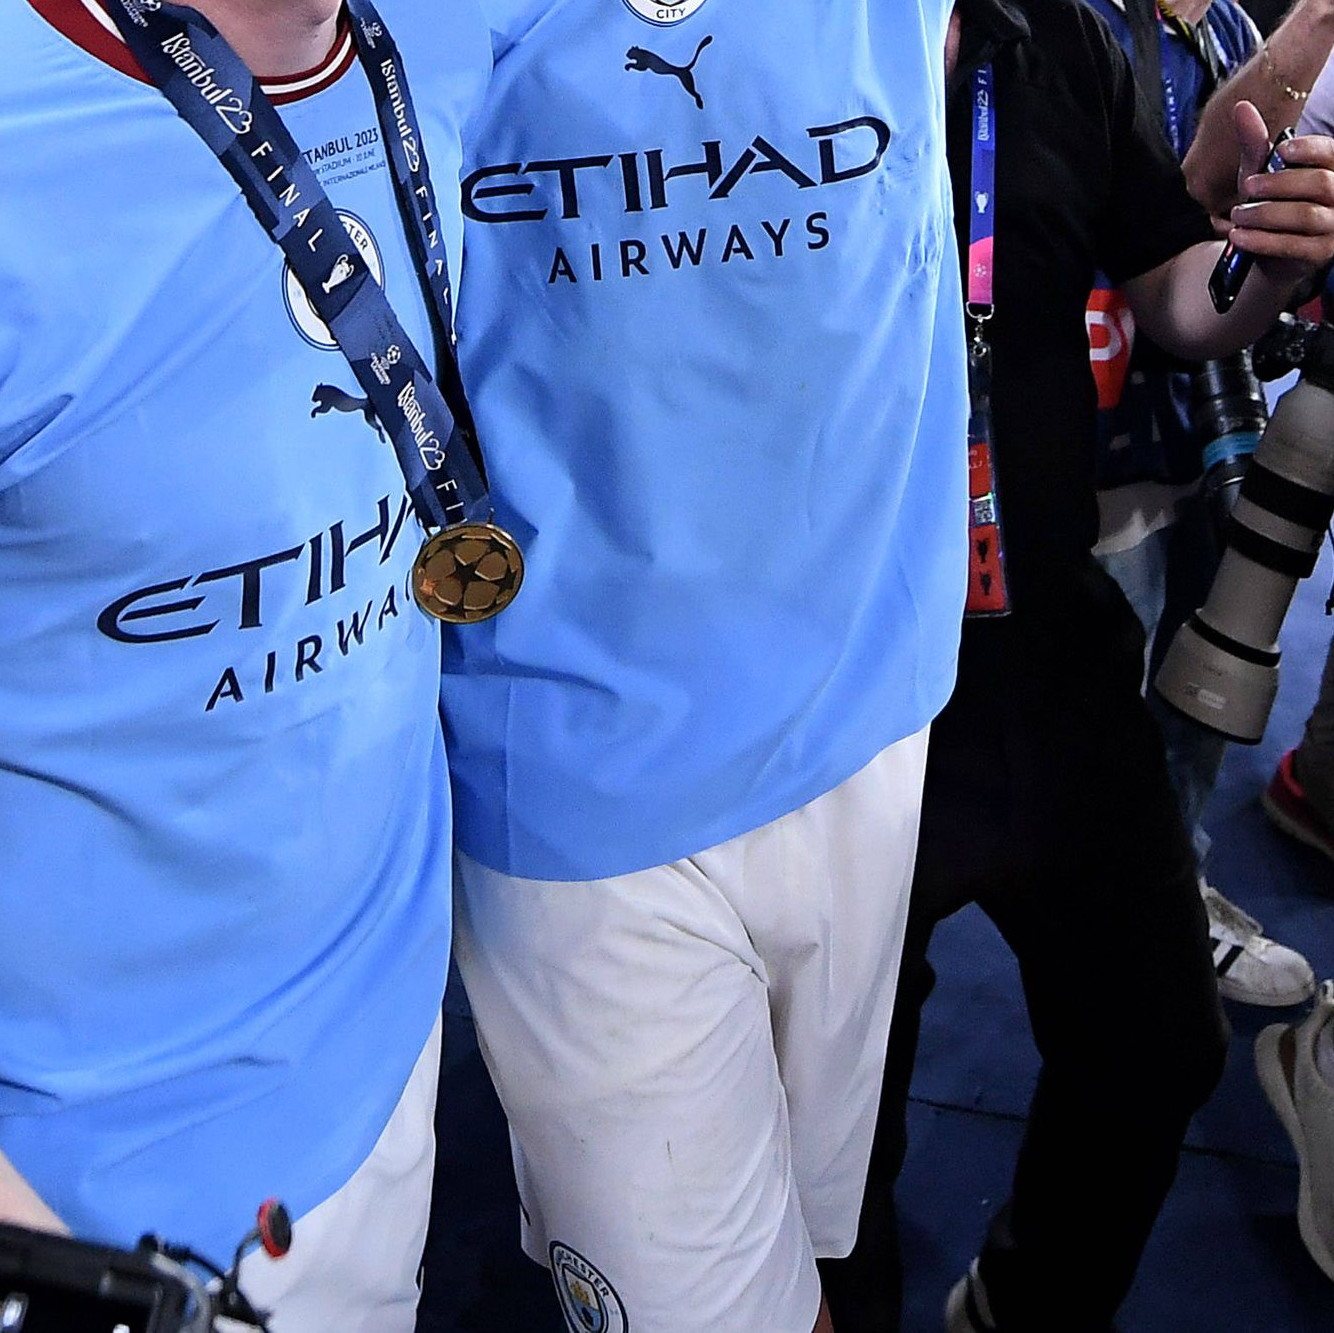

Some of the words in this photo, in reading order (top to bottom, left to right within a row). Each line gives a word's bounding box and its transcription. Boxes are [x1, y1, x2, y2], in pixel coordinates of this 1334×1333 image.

[656, 7, 687, 20] CITY
[250, 140, 324, 253] FINAL
[301, 136, 353, 165] TANBUL
[354, 127, 380, 148] 2023
[459, 115, 893, 224] ETIHAD
[547, 211, 831, 285] AIRWAYS
[96, 494, 416, 644] ETIH
[205, 569, 410, 713] AIRWA
